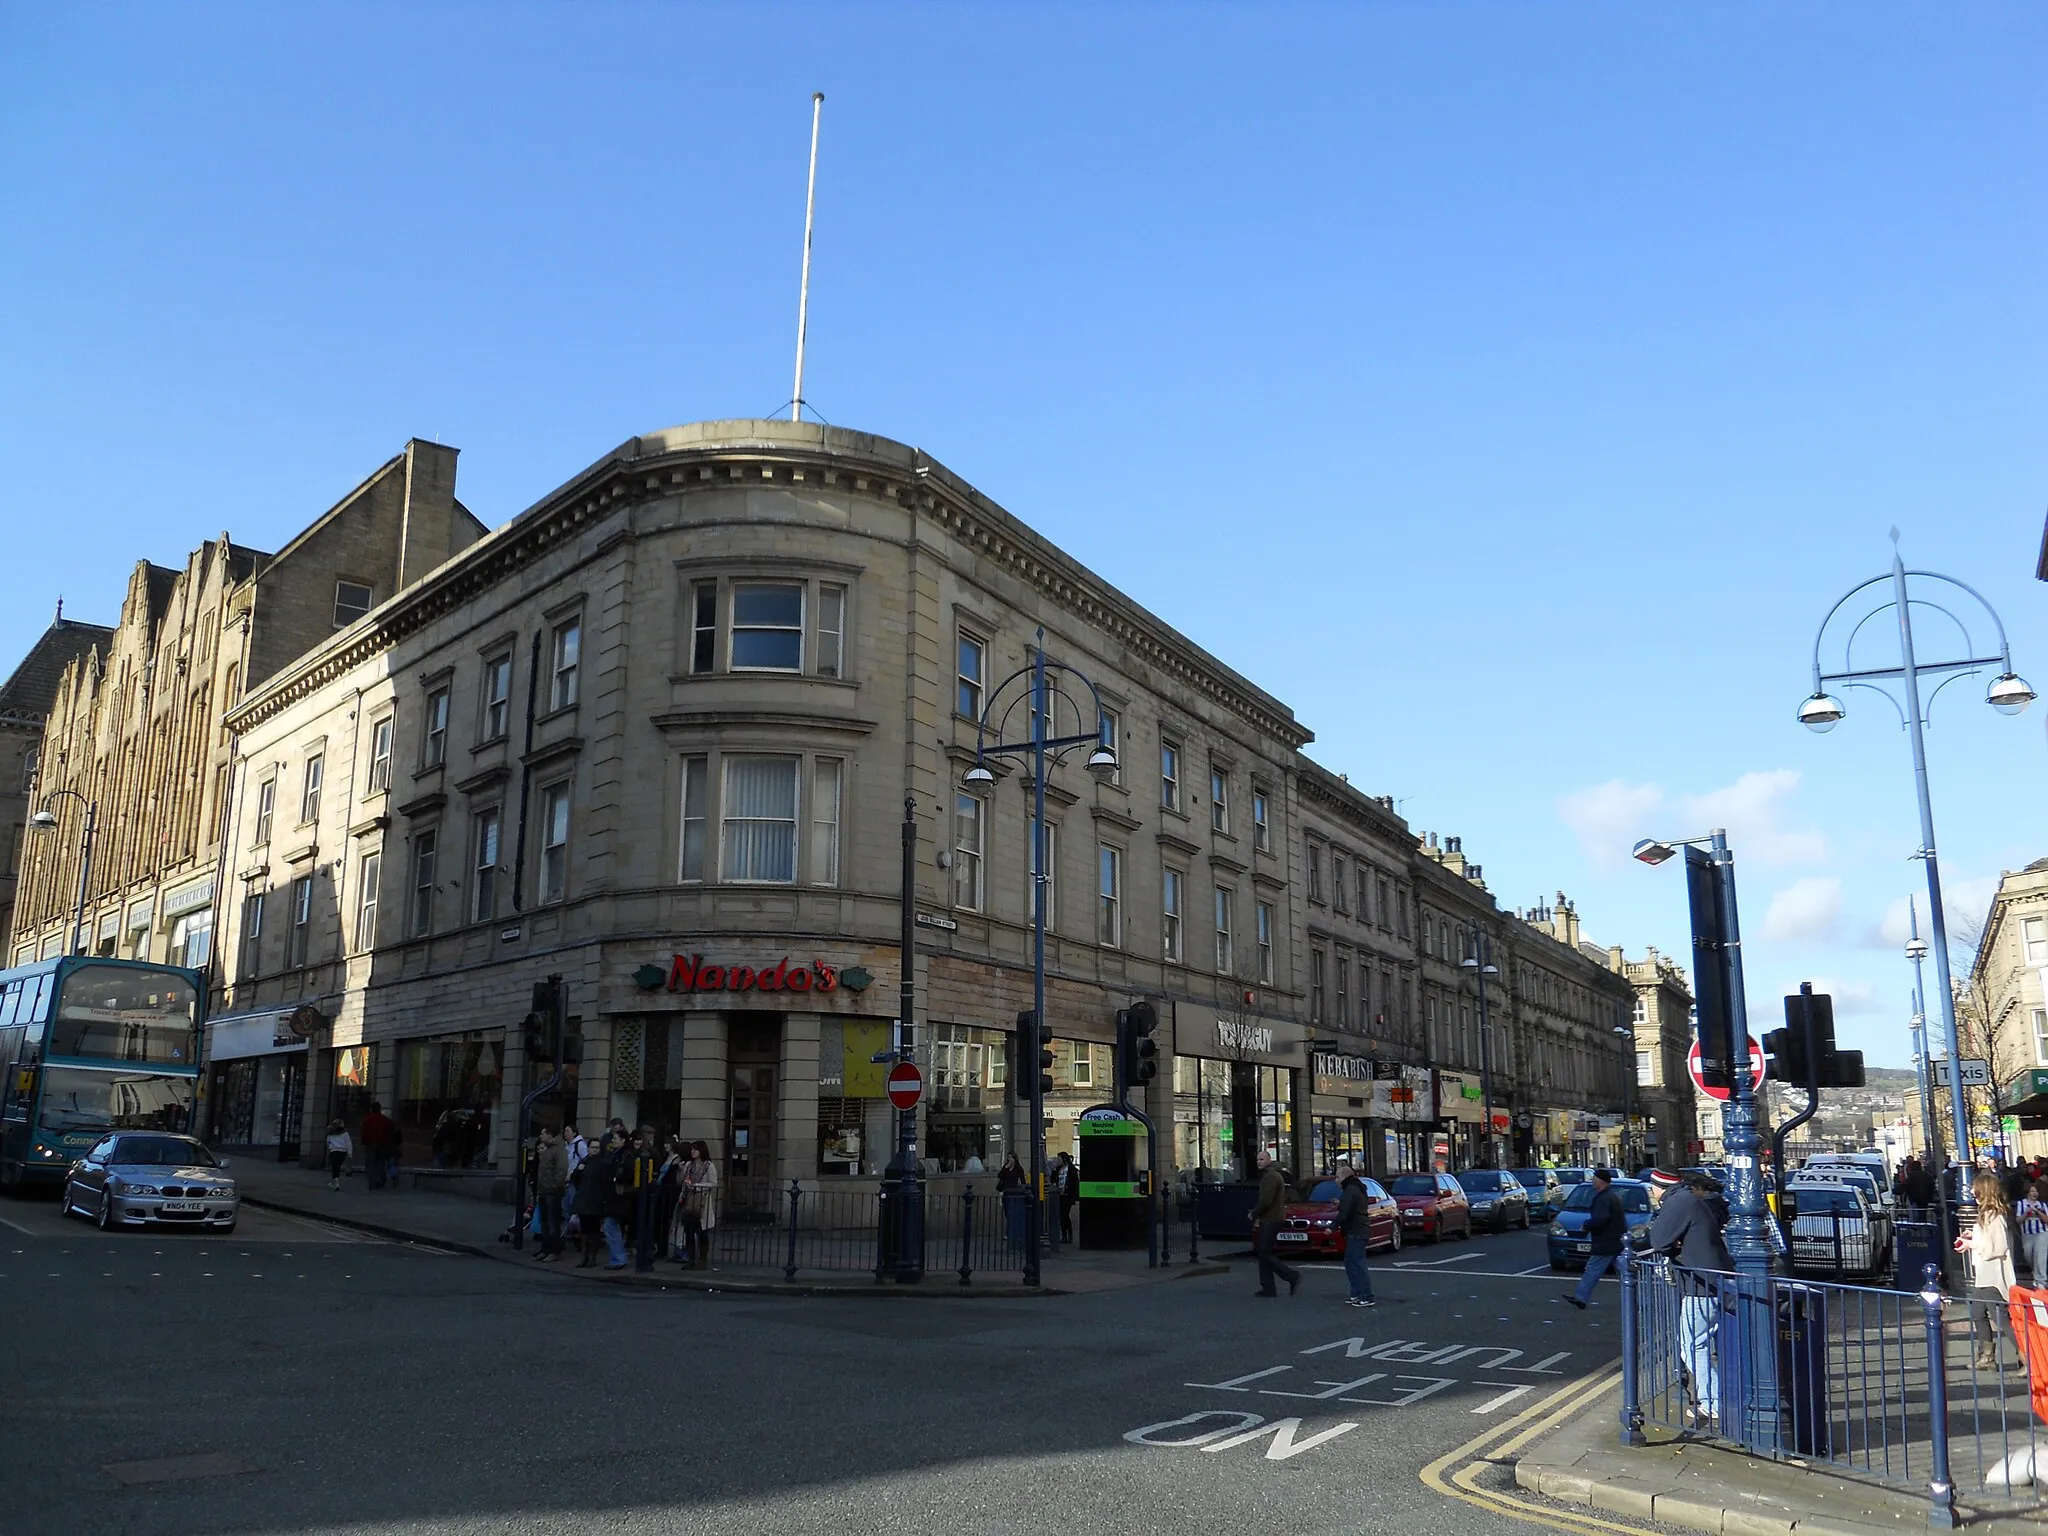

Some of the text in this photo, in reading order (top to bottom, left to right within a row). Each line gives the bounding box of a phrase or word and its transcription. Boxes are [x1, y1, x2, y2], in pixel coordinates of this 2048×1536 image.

[668, 953, 838, 993] Nando's
[1318, 1055, 1374, 1081] KEBABISH
[1940, 1066, 1984, 1080] Txis
[1086, 1113, 1101, 1121] Free
[1103, 1113, 1121, 1121] Cash
[63, 1136, 97, 1145] Conne
[1797, 1174, 1838, 1182] TAXI
[1780, 1330, 1801, 1341] TER
[1301, 1336, 1572, 1375] TURN
[1184, 1364, 1536, 1415] LEFT
[1122, 1410, 1359, 1460] NO
